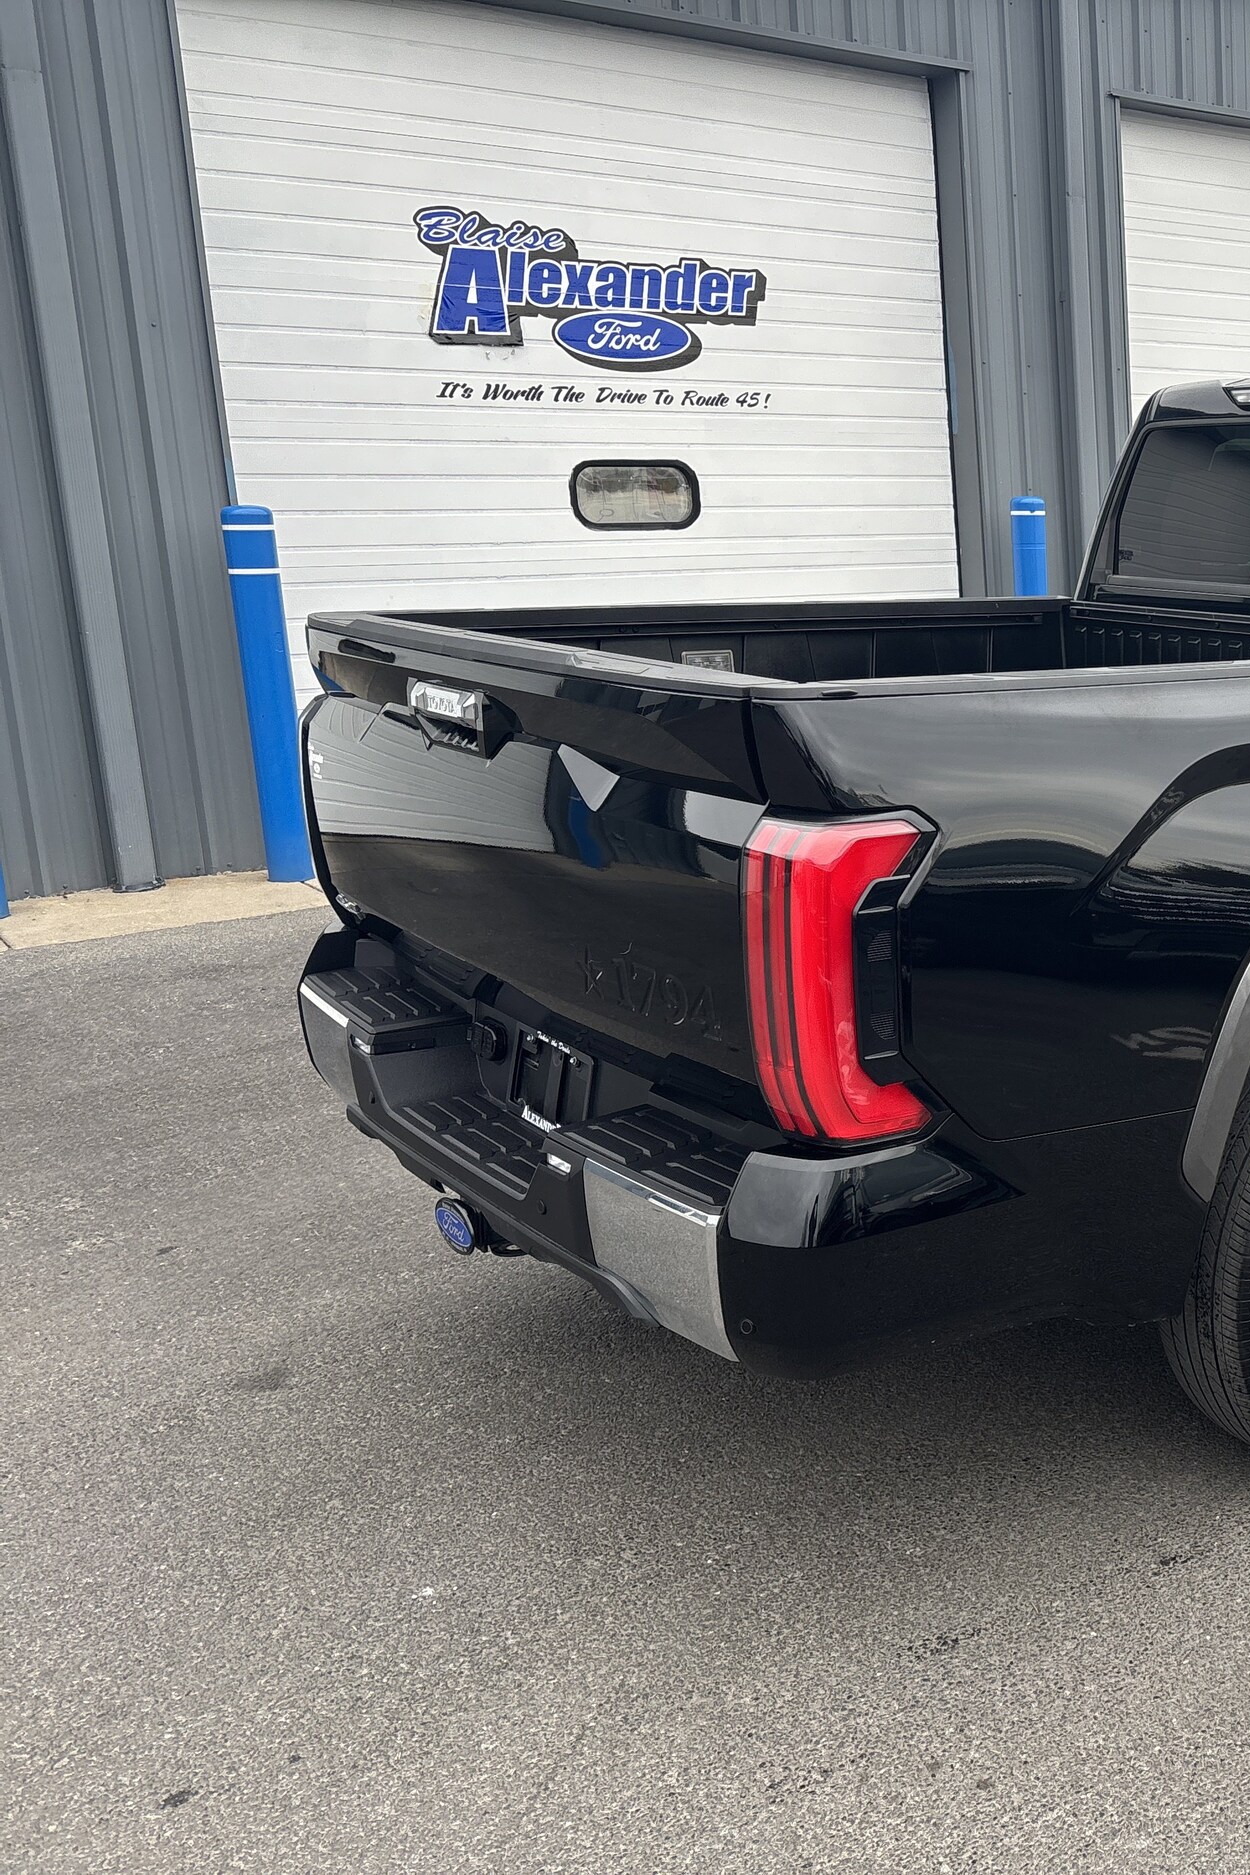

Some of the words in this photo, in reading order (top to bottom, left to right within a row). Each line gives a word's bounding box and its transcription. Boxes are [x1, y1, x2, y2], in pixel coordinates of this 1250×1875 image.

[415, 209, 567, 251] Blaise
[433, 244, 758, 337] Alexander
[587, 318, 661, 351] Ford
[436, 381, 474, 399] It's
[482, 383, 544, 402] Worth
[551, 385, 585, 403] The
[595, 387, 647, 405] Drive
[653, 389, 674, 405] To
[681, 390, 730, 407] Route
[427, 694, 457, 715] TOYOTA
[611, 957, 722, 1042] 1794
[442, 1211, 465, 1242] Ford
